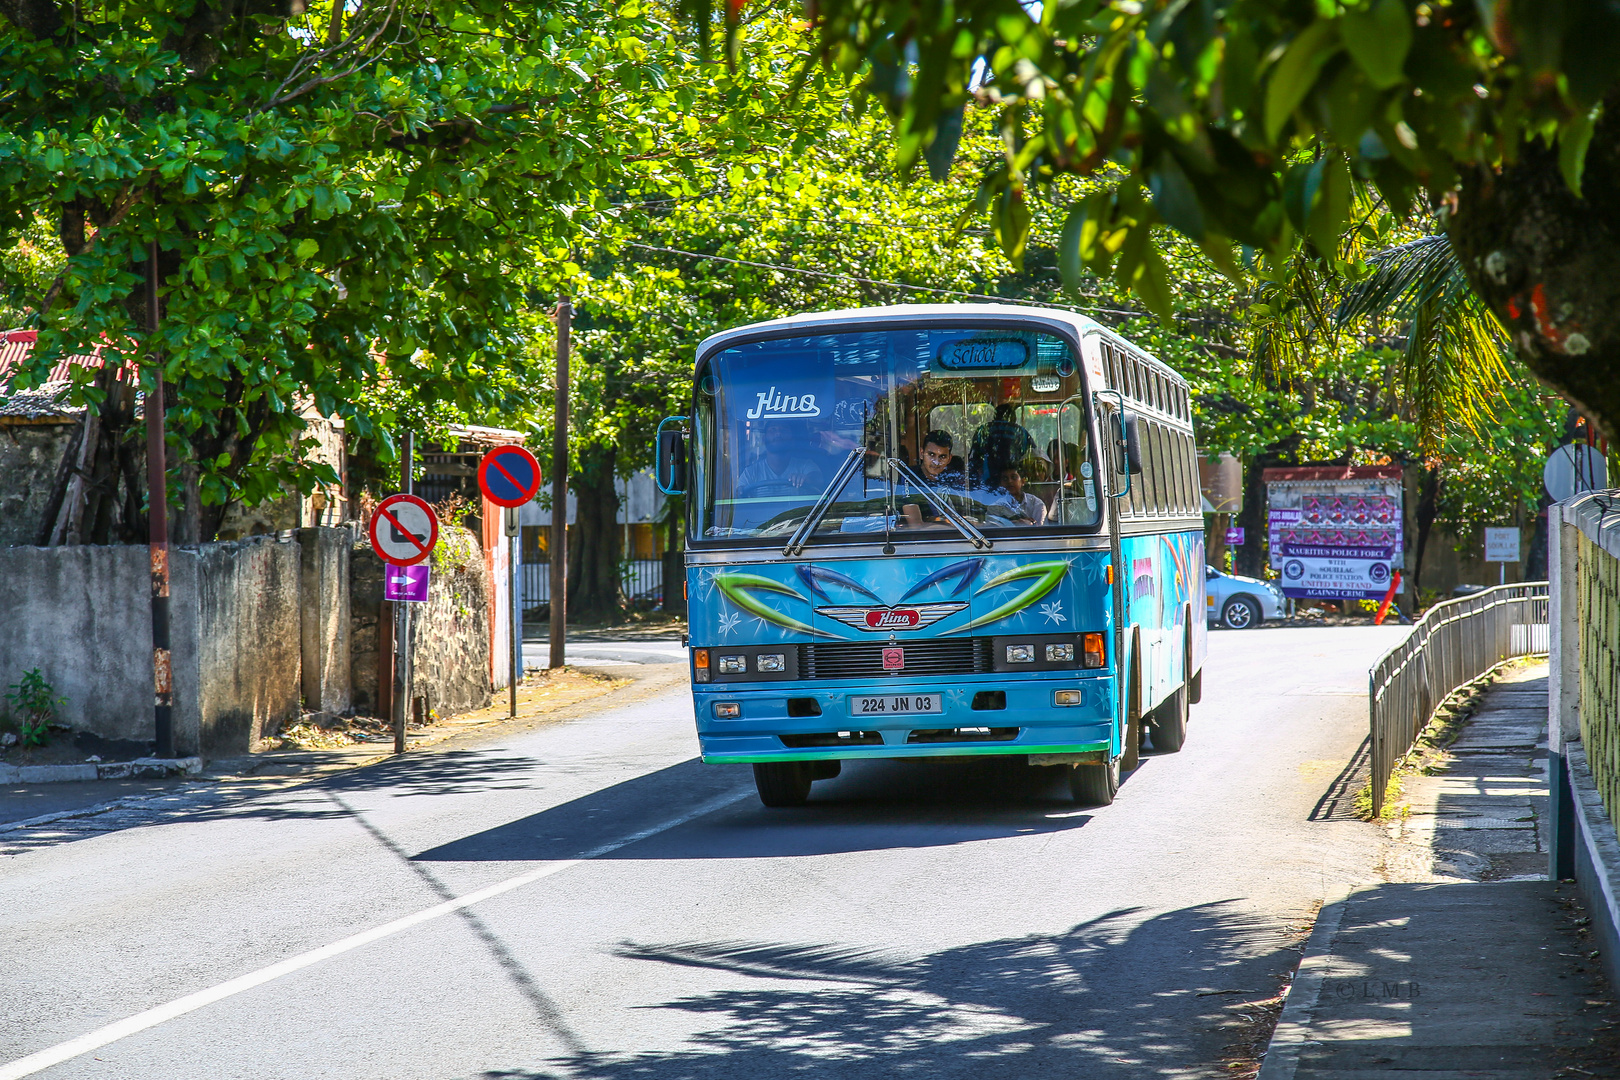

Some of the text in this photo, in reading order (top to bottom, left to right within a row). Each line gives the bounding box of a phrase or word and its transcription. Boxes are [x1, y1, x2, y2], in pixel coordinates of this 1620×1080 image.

[746, 386, 821, 419] Hino
[1288, 547, 1330, 556] MAURITIUS
[1331, 549, 1359, 557] POLICE
[1360, 550, 1386, 558] FORCE
[1301, 580, 1330, 588] UNITED
[1346, 581, 1372, 589] STAND
[1306, 588, 1367, 598] AGAINST CRIME
[875, 611, 910, 627] Hino
[862, 697, 931, 712] 224 JN 03
